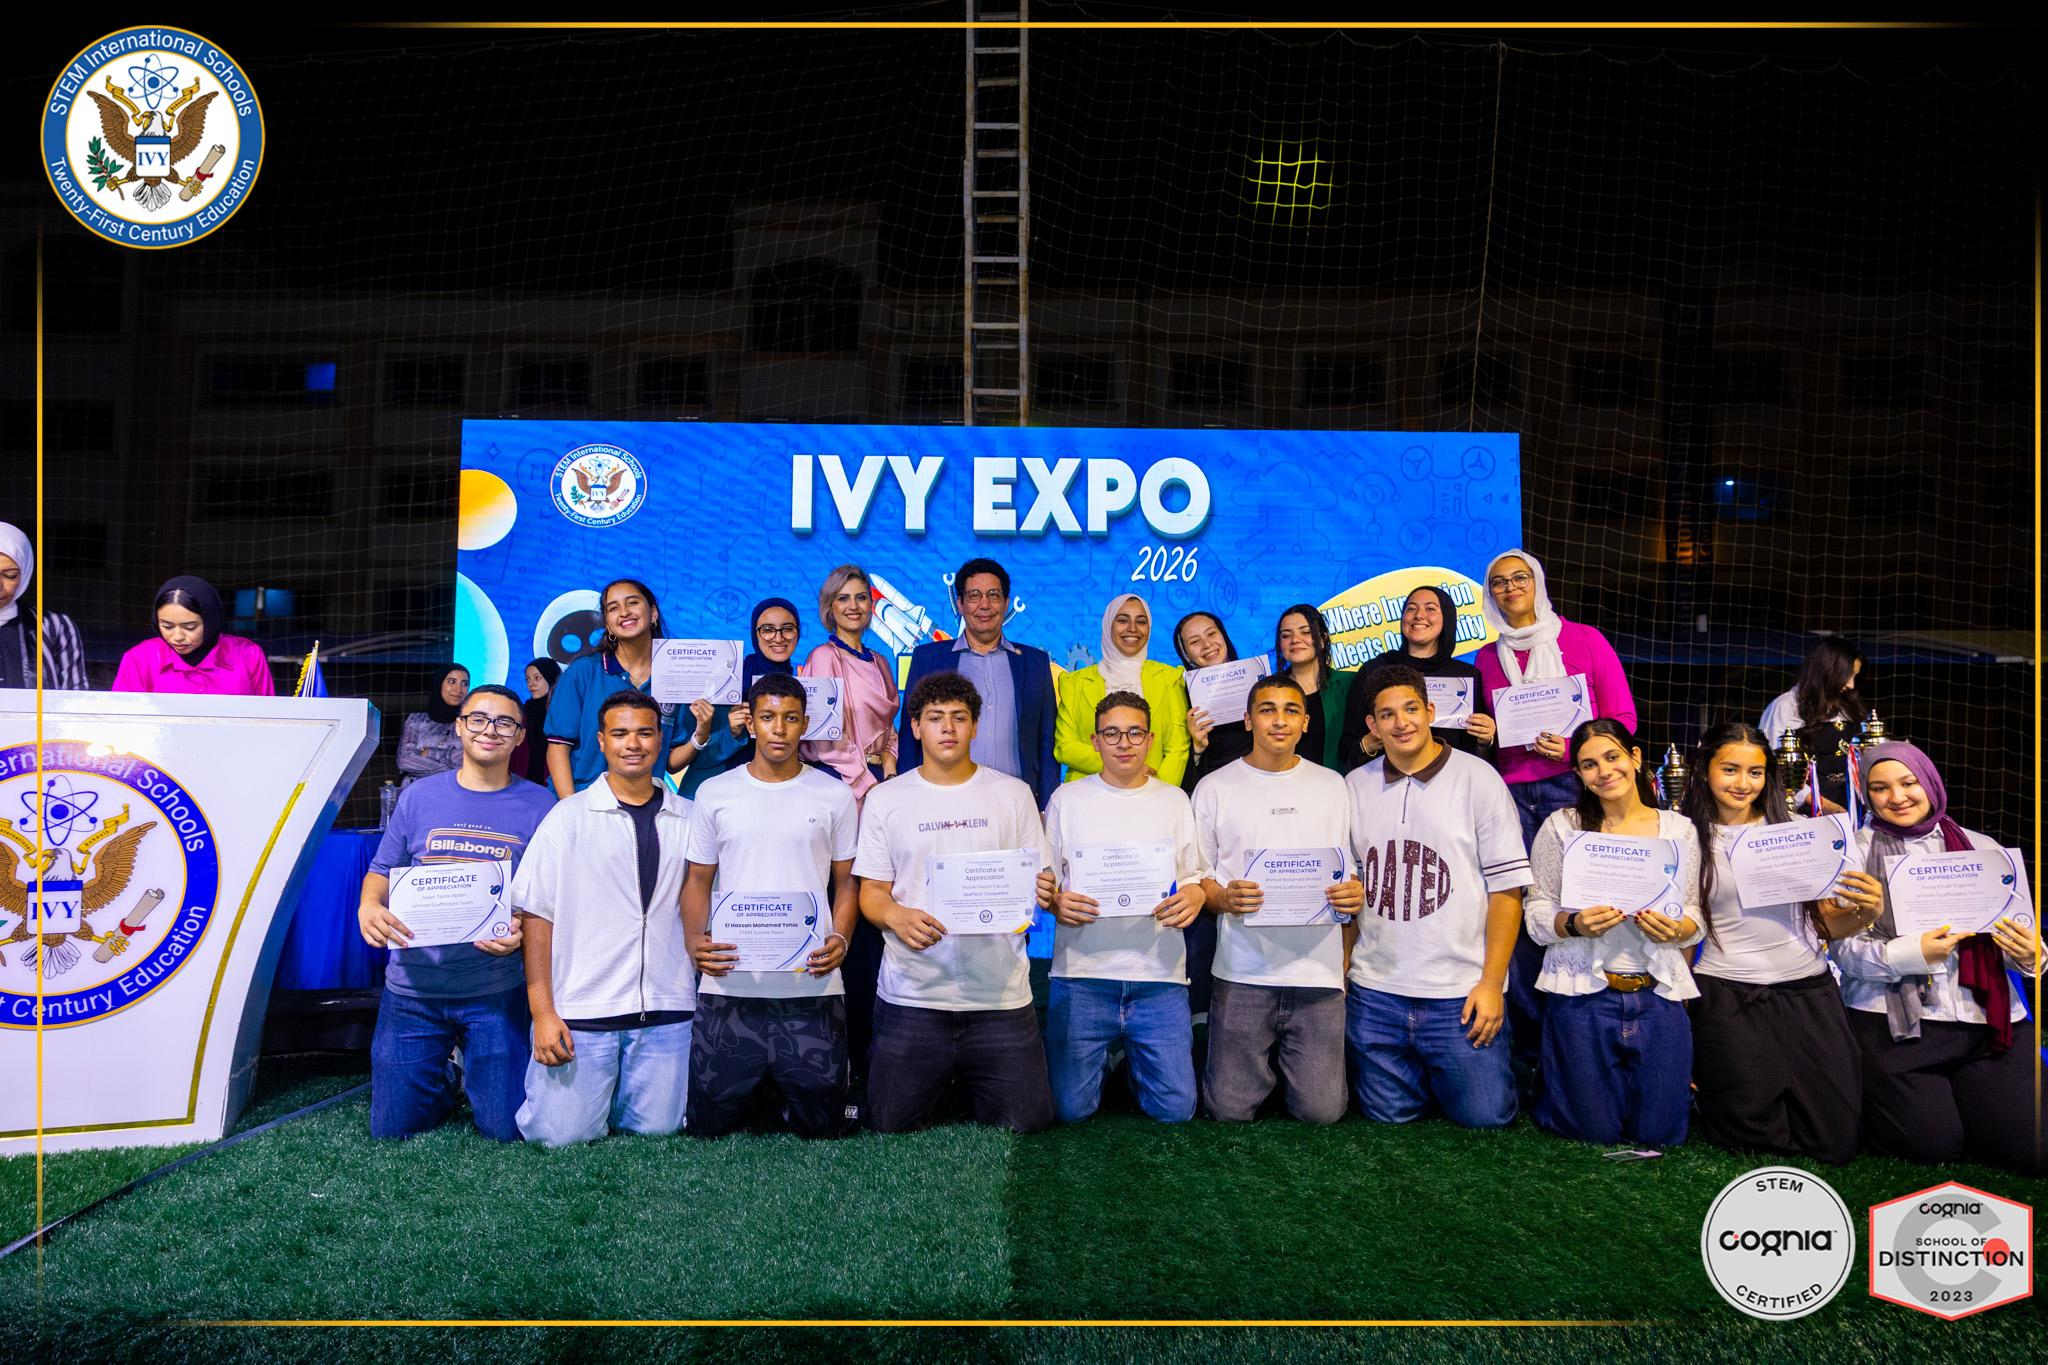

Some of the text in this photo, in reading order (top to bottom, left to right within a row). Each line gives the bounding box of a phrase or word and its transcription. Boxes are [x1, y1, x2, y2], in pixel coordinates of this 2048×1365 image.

[555, 446, 642, 479] STEM International Schools
[792, 454, 1211, 540] IVY EXPO
[586, 517, 616, 525] Century
[616, 494, 642, 519] Education
[1131, 546, 1200, 582] 2026
[1321, 602, 1382, 634] Where
[1331, 636, 1383, 669] Meets
[1201, 668, 1247, 683] CERTIFICATE
[1509, 688, 1560, 702] CERTIFICATE
[137, 769, 205, 853] Schools
[918, 820, 950, 832] CALVIN
[962, 818, 988, 829] KLEIN
[430, 840, 506, 858] Billabong
[1748, 832, 1816, 848] CERTIFICATE
[1585, 844, 1651, 858] CERTIFICATE
[1264, 860, 1322, 868] CERTIFICATE
[1909, 864, 1984, 875] CERTIFICATE
[412, 875, 478, 886] CERTIFICATE
[31, 901, 79, 920] IVY
[12, 905, 206, 1018] Century Education
